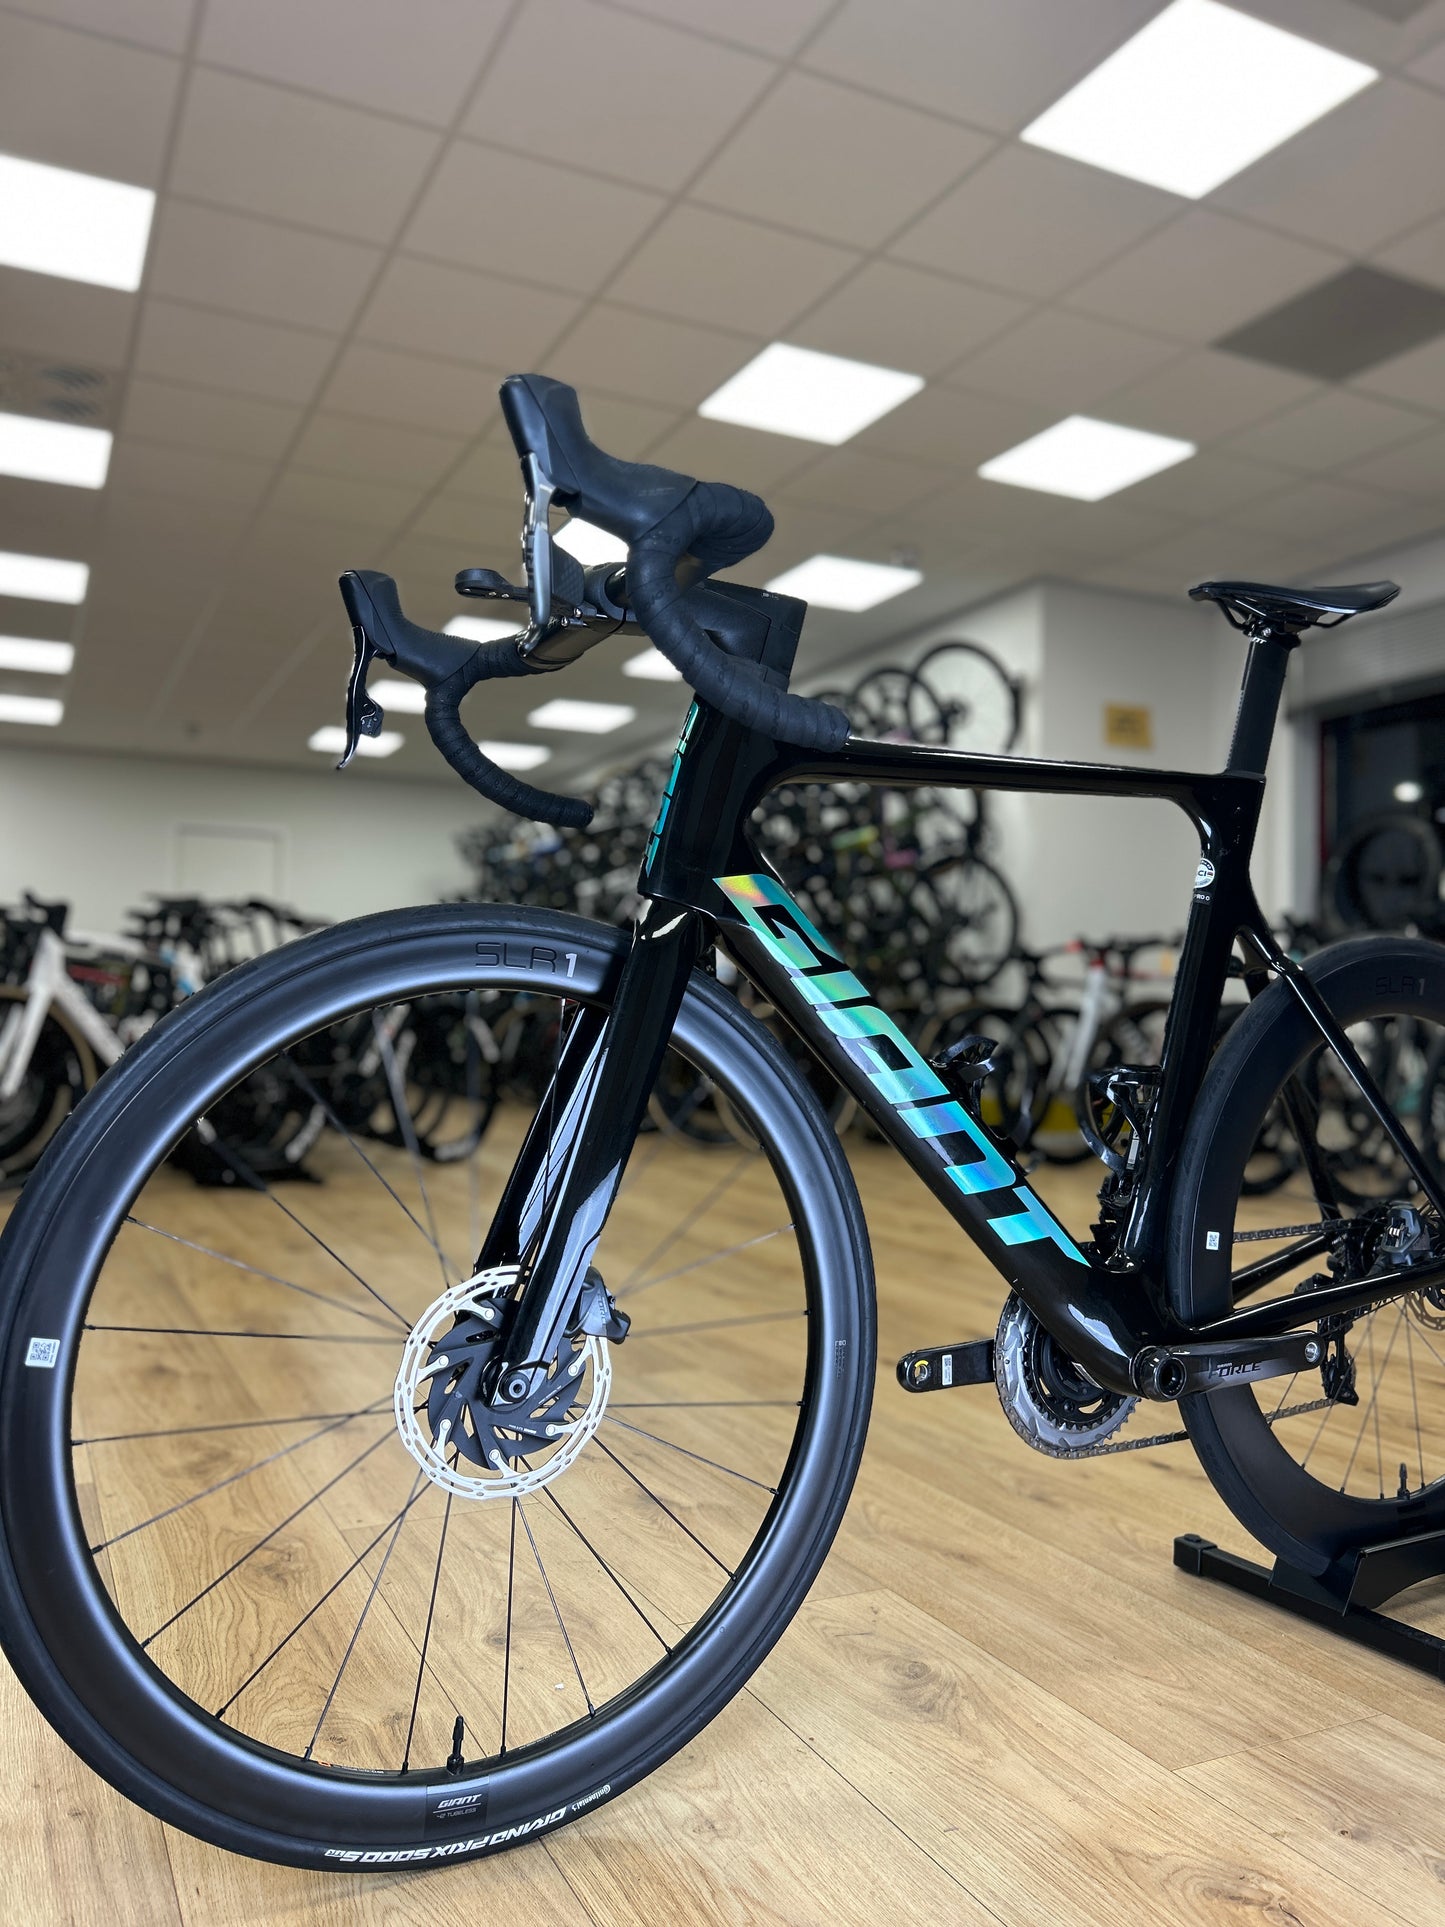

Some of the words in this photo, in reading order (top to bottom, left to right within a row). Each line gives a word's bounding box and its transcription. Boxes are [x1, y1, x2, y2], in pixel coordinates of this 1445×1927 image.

[475, 942, 557, 974] SLR
[565, 953, 578, 978] 1
[713, 874, 1092, 1267] GIANT
[1208, 1362, 1262, 1379] FORCE
[437, 1793, 482, 1809] GIANT
[489, 1807, 567, 1846] GRAND
[429, 1836, 490, 1859] PRIX
